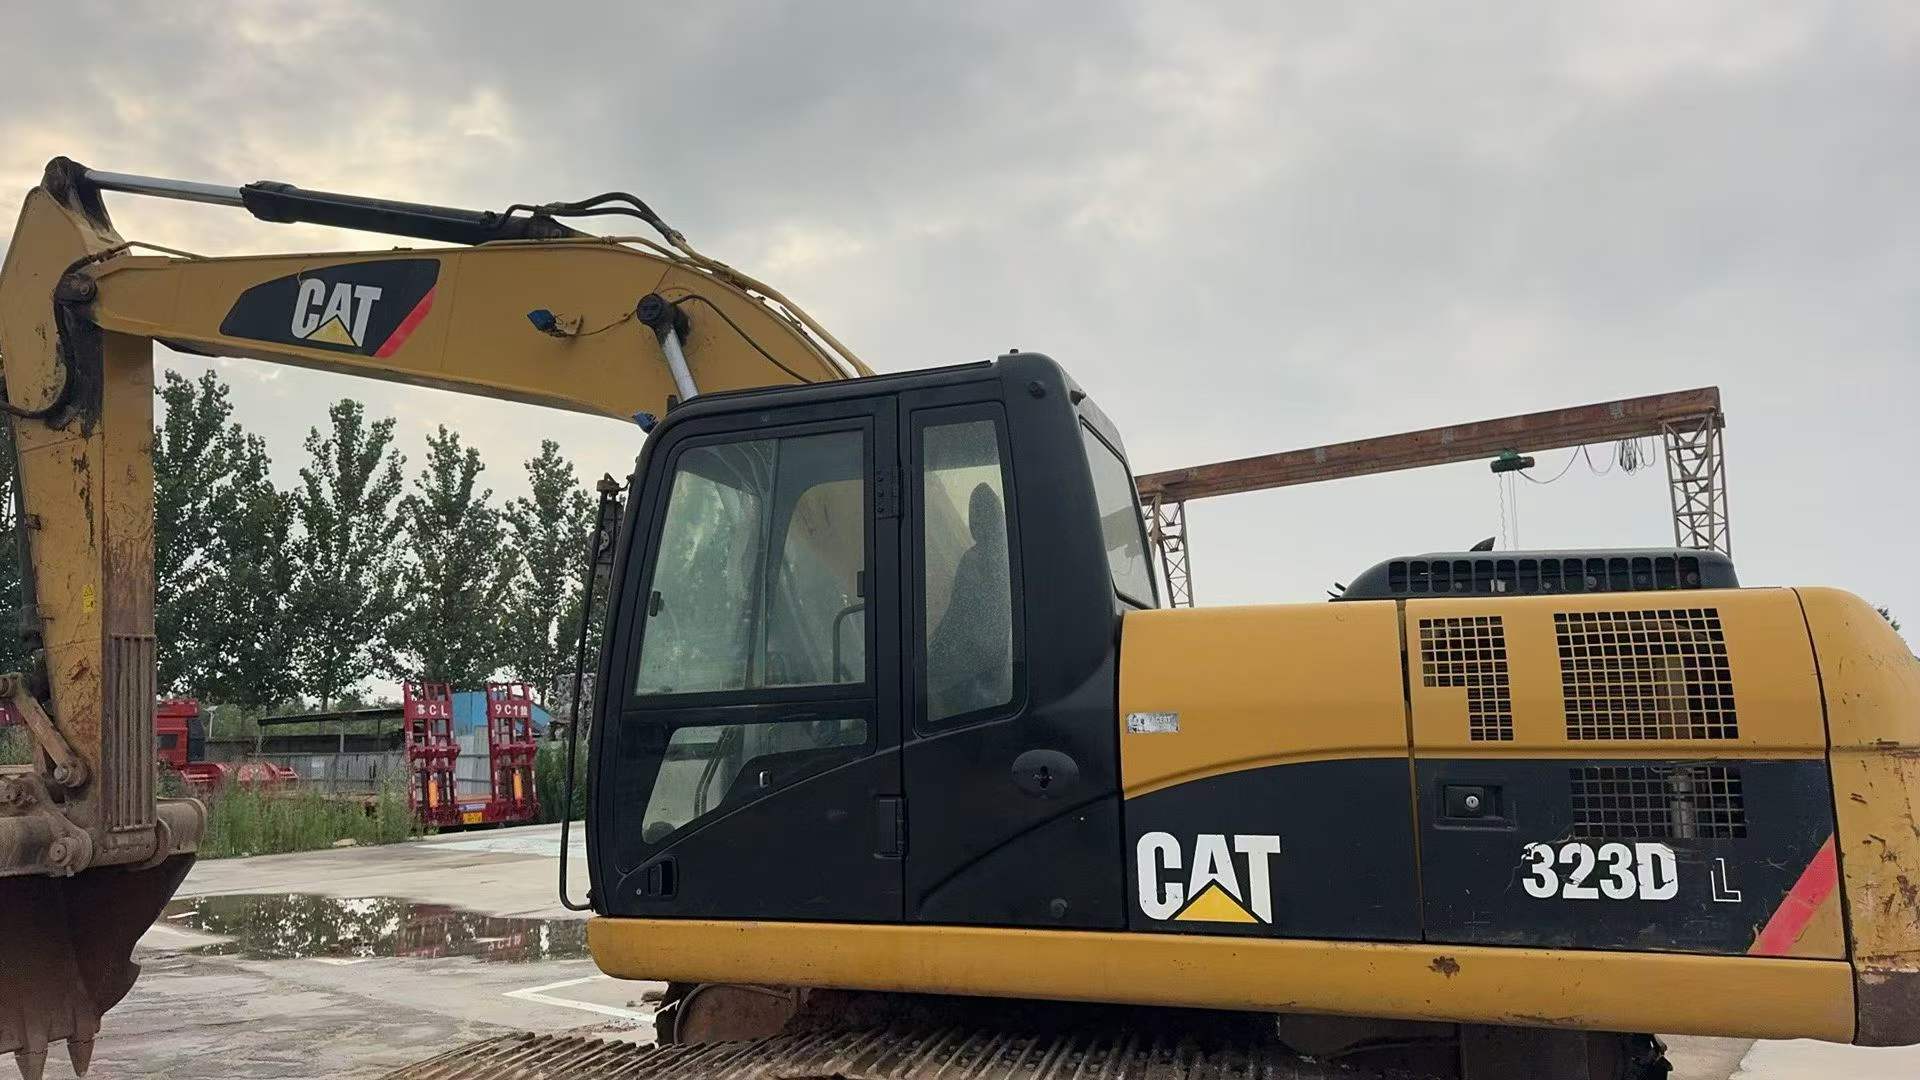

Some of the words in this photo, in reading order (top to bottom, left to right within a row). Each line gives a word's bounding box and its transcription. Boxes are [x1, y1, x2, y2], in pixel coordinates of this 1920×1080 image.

[291, 278, 382, 347] CAT
[1137, 832, 1281, 923] CAT
[1521, 842, 1678, 900] 323D
[1710, 857, 1742, 902] L
